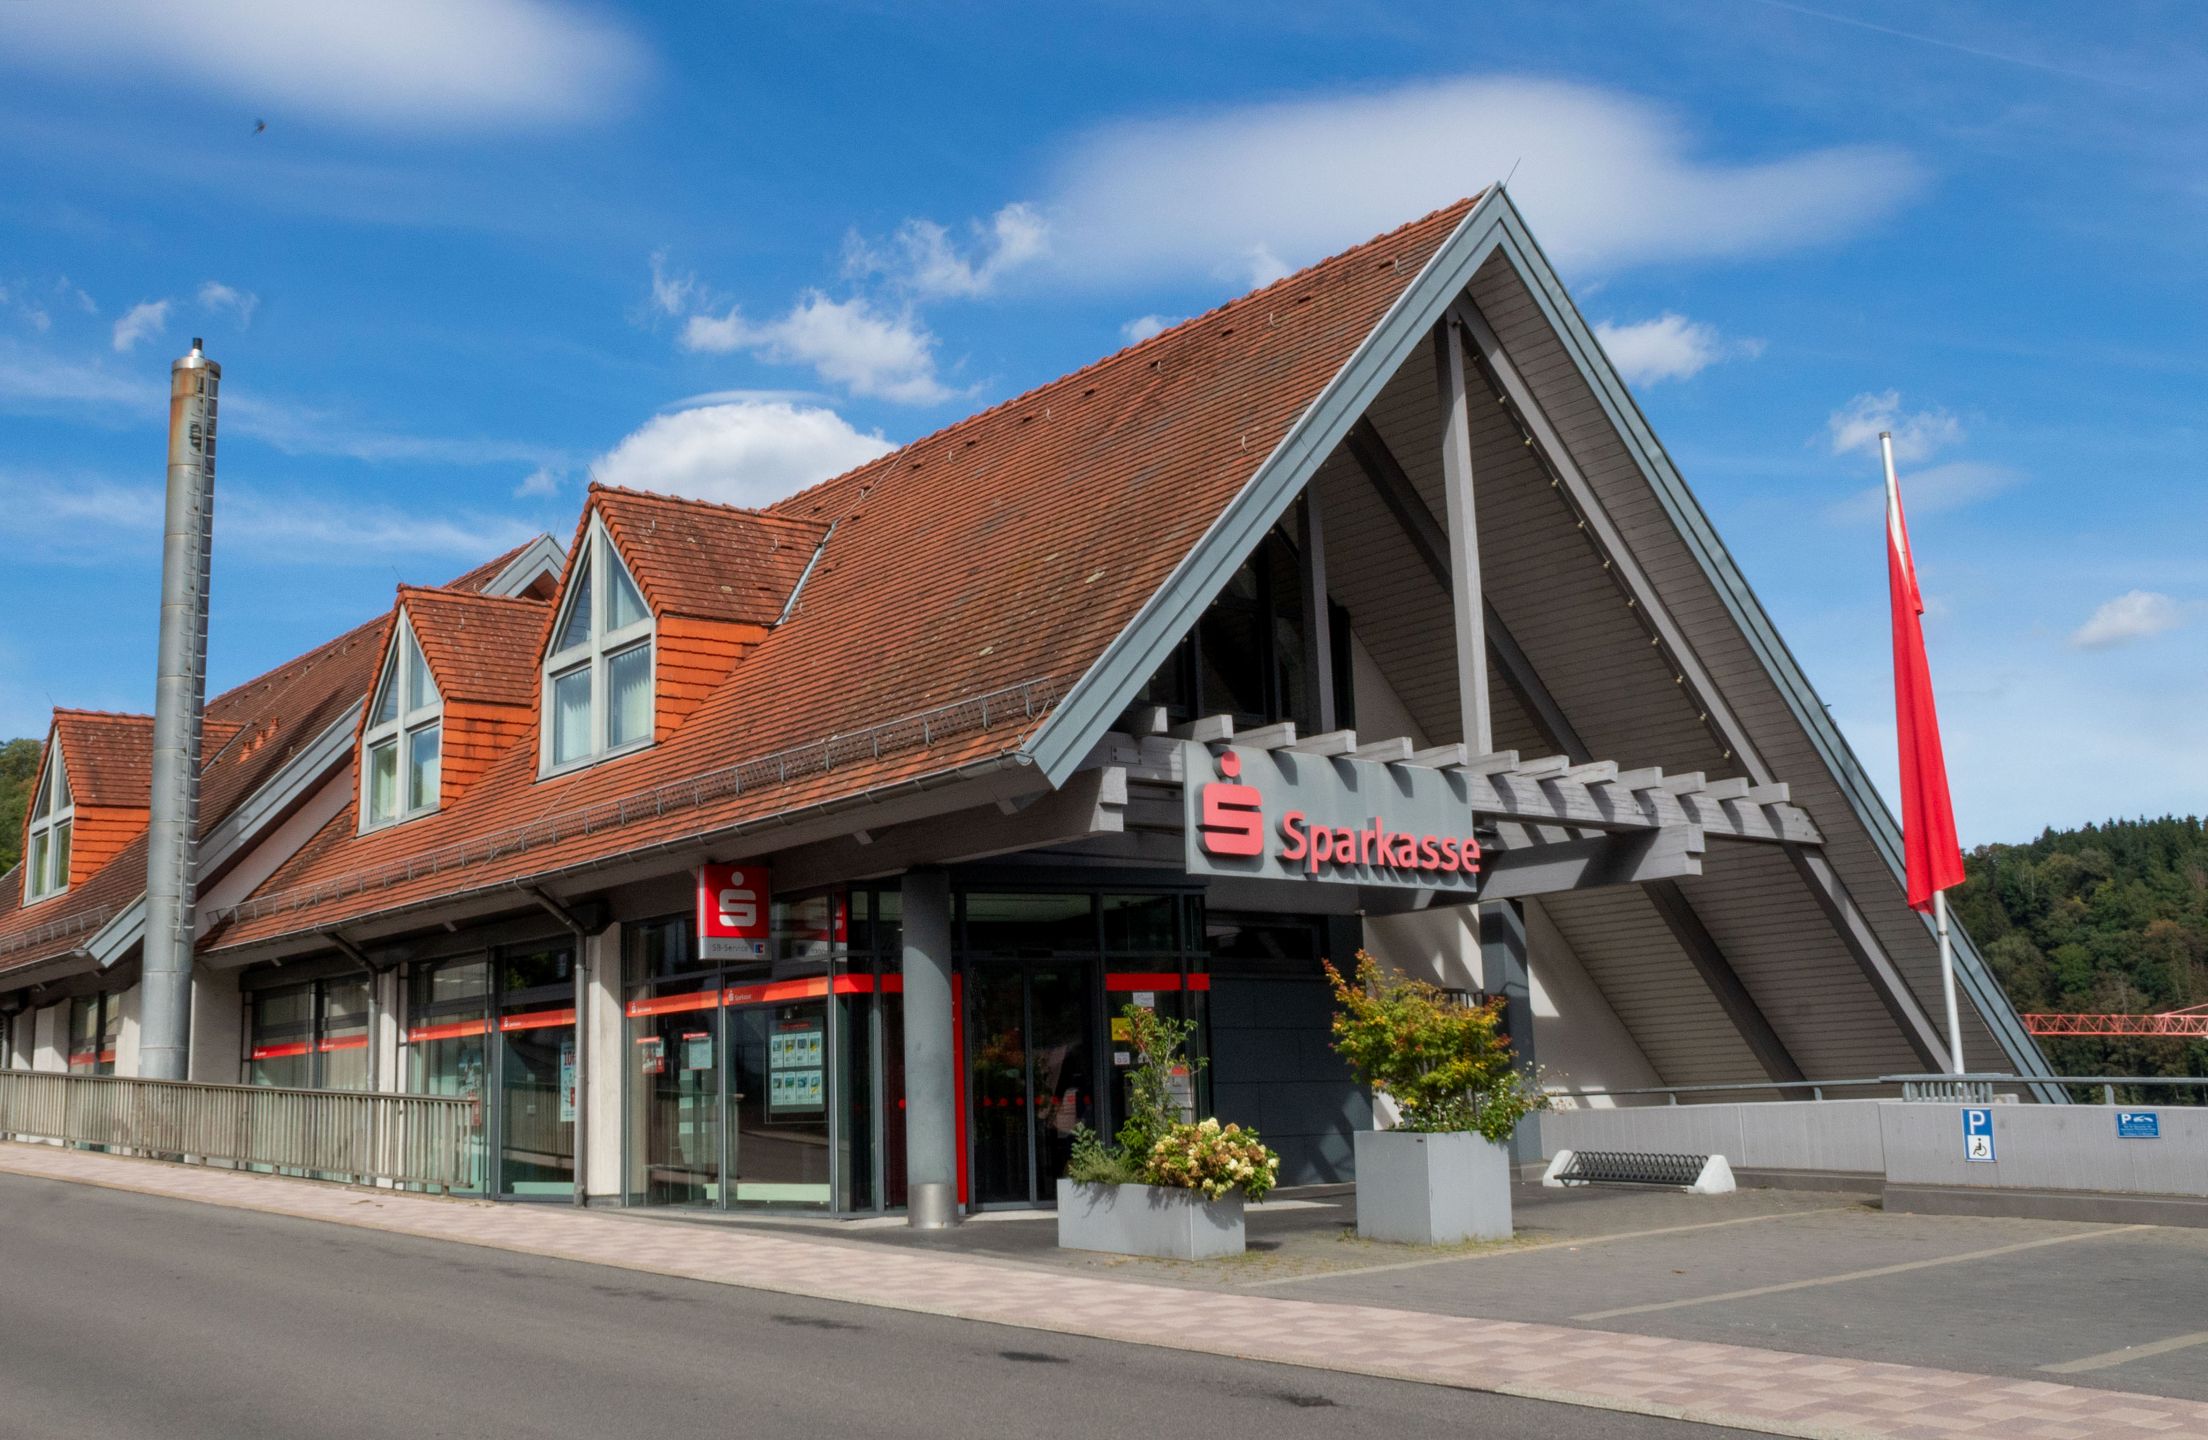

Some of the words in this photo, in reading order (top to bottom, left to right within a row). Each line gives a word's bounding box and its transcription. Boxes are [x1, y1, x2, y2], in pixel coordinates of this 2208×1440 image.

[1282, 811, 1481, 873] Sparkasse
[1968, 1110, 1986, 1135] P
[2121, 1113, 2132, 1124] P
